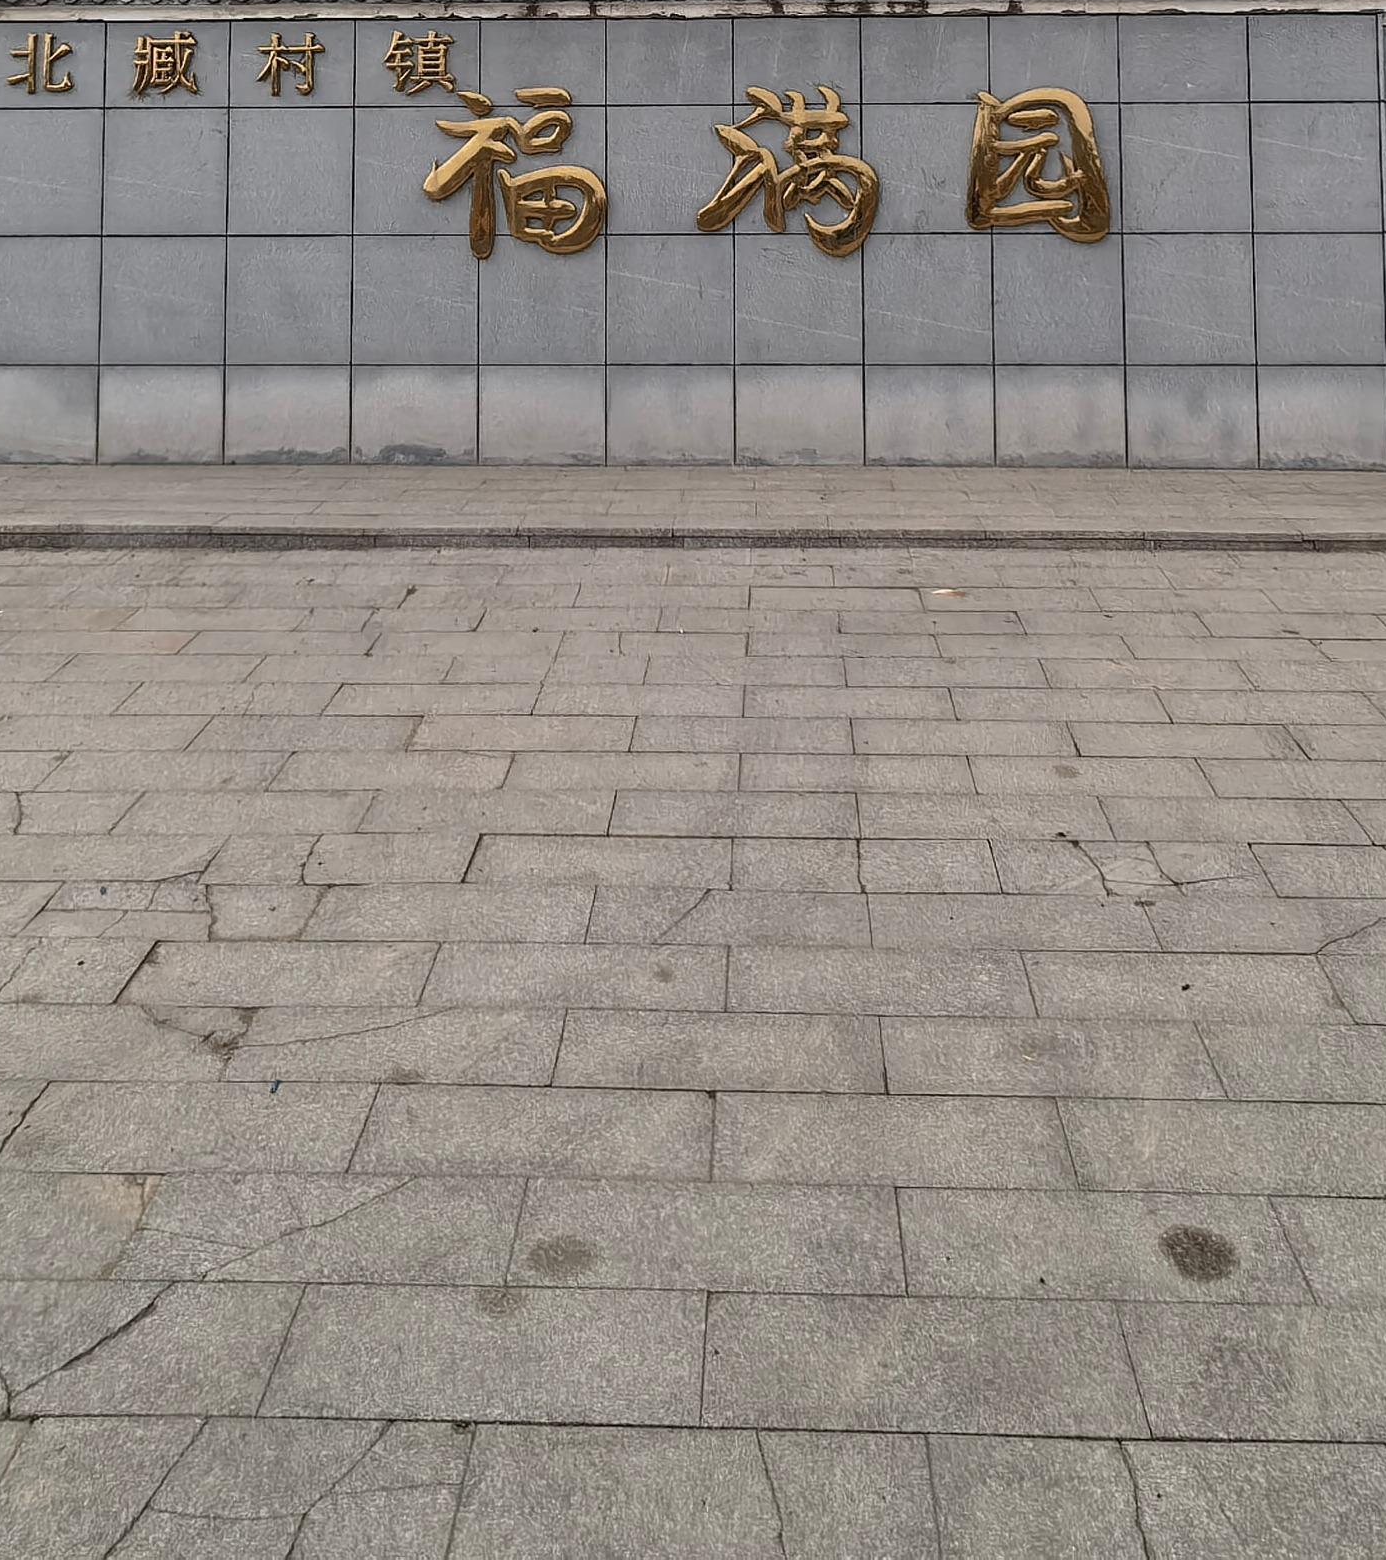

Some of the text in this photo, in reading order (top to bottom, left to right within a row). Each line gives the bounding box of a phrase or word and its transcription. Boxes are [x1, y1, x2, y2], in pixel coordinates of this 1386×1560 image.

[6, 30, 458, 98] 北臧村镇
[422, 85, 1113, 261] 福满园
